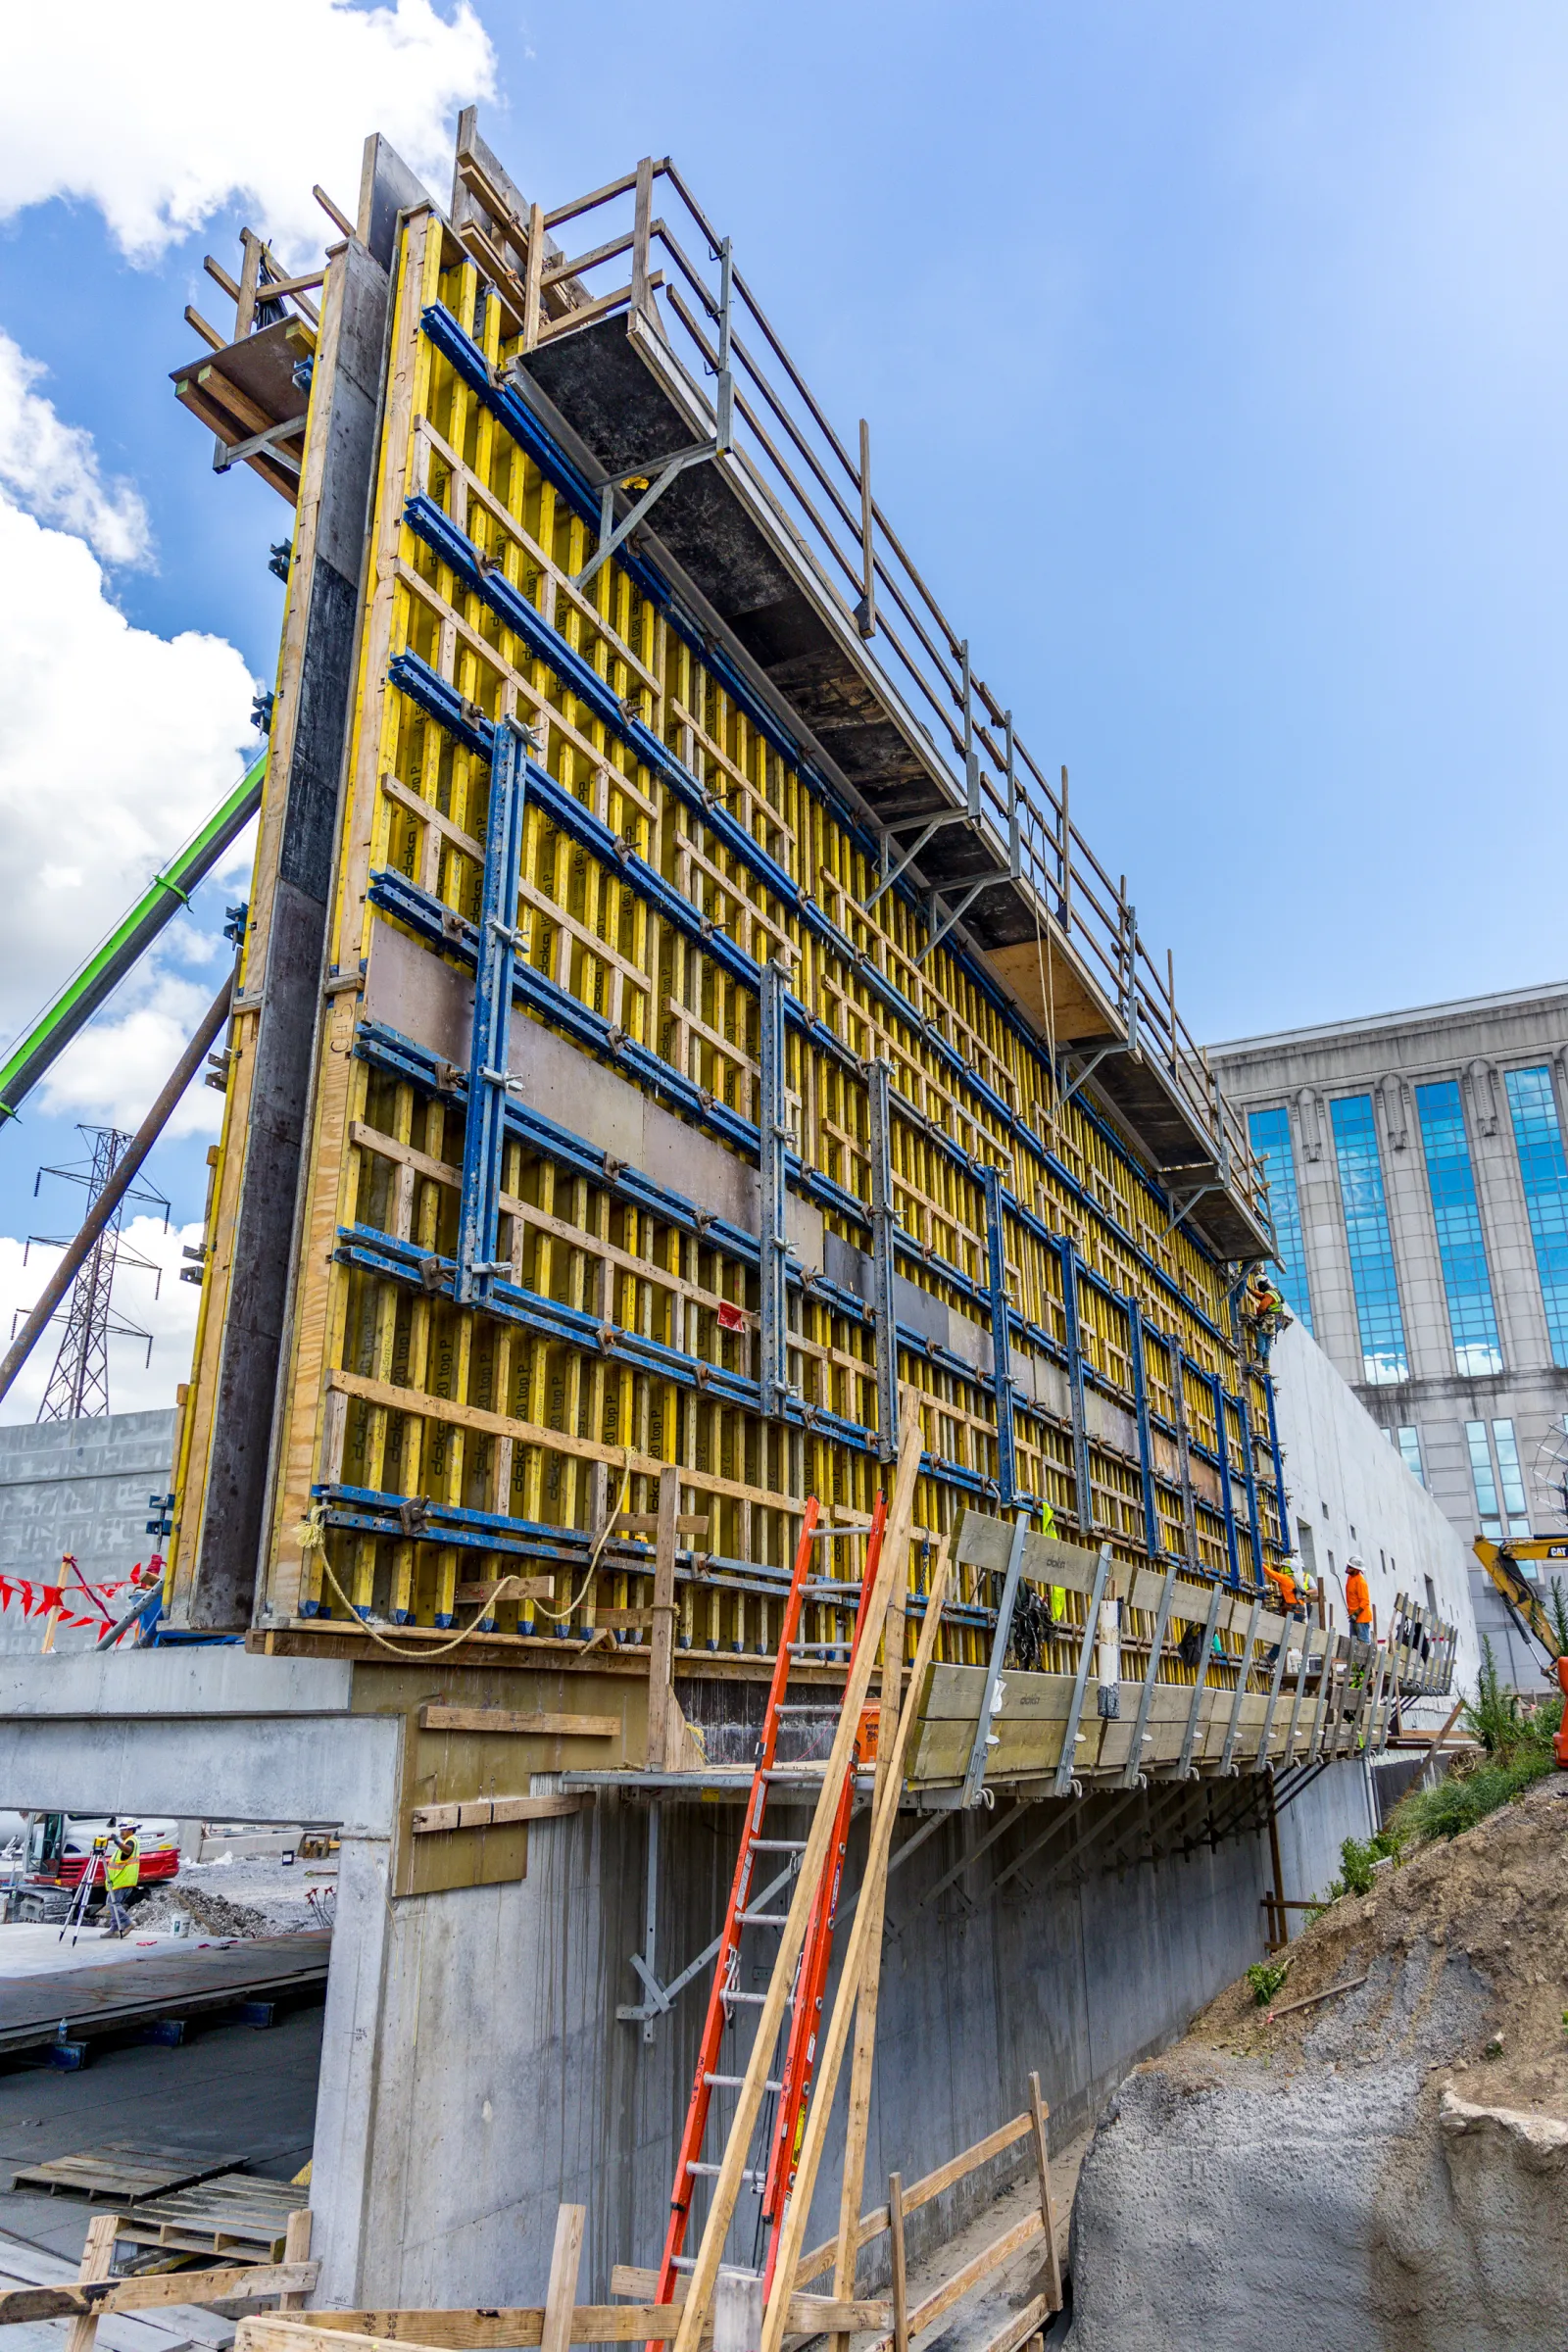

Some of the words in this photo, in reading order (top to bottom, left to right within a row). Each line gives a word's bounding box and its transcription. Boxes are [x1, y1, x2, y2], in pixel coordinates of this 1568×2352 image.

[526, 578, 538, 594] top
[556, 612, 567, 627] top
[632, 619, 642, 637] H20
[403, 830, 416, 879] doka
[411, 765, 421, 774] P
[470, 879, 482, 924] doka
[476, 817, 486, 826] P
[621, 890, 633, 906] top
[538, 933, 551, 976] doka
[661, 981, 672, 995] top
[660, 1022, 670, 1061] doka
[724, 1070, 734, 1107] doka
[398, 1322, 410, 1332] P
[395, 1338, 410, 1360] top
[439, 1339, 451, 1348] P
[437, 1354, 452, 1377] top
[479, 1352, 491, 1363] P
[360, 1360, 373, 1378] 20
[393, 1366, 407, 1386] 20
[517, 1364, 528, 1373] P
[478, 1368, 492, 1391] top
[515, 1377, 530, 1399] top
[552, 1376, 563, 1385] P
[436, 1381, 450, 1398] 20
[477, 1395, 490, 1411] 20
[551, 1390, 564, 1411] top
[515, 1404, 527, 1420] 20
[605, 1407, 618, 1427] top
[550, 1416, 563, 1431] 20
[650, 1421, 663, 1441] top
[604, 1432, 615, 1446] 20
[431, 1420, 446, 1477] doka
[649, 1446, 661, 1459] 20
[803, 1469, 815, 1486] top
[1550, 1547, 1567, 1556] CAT
